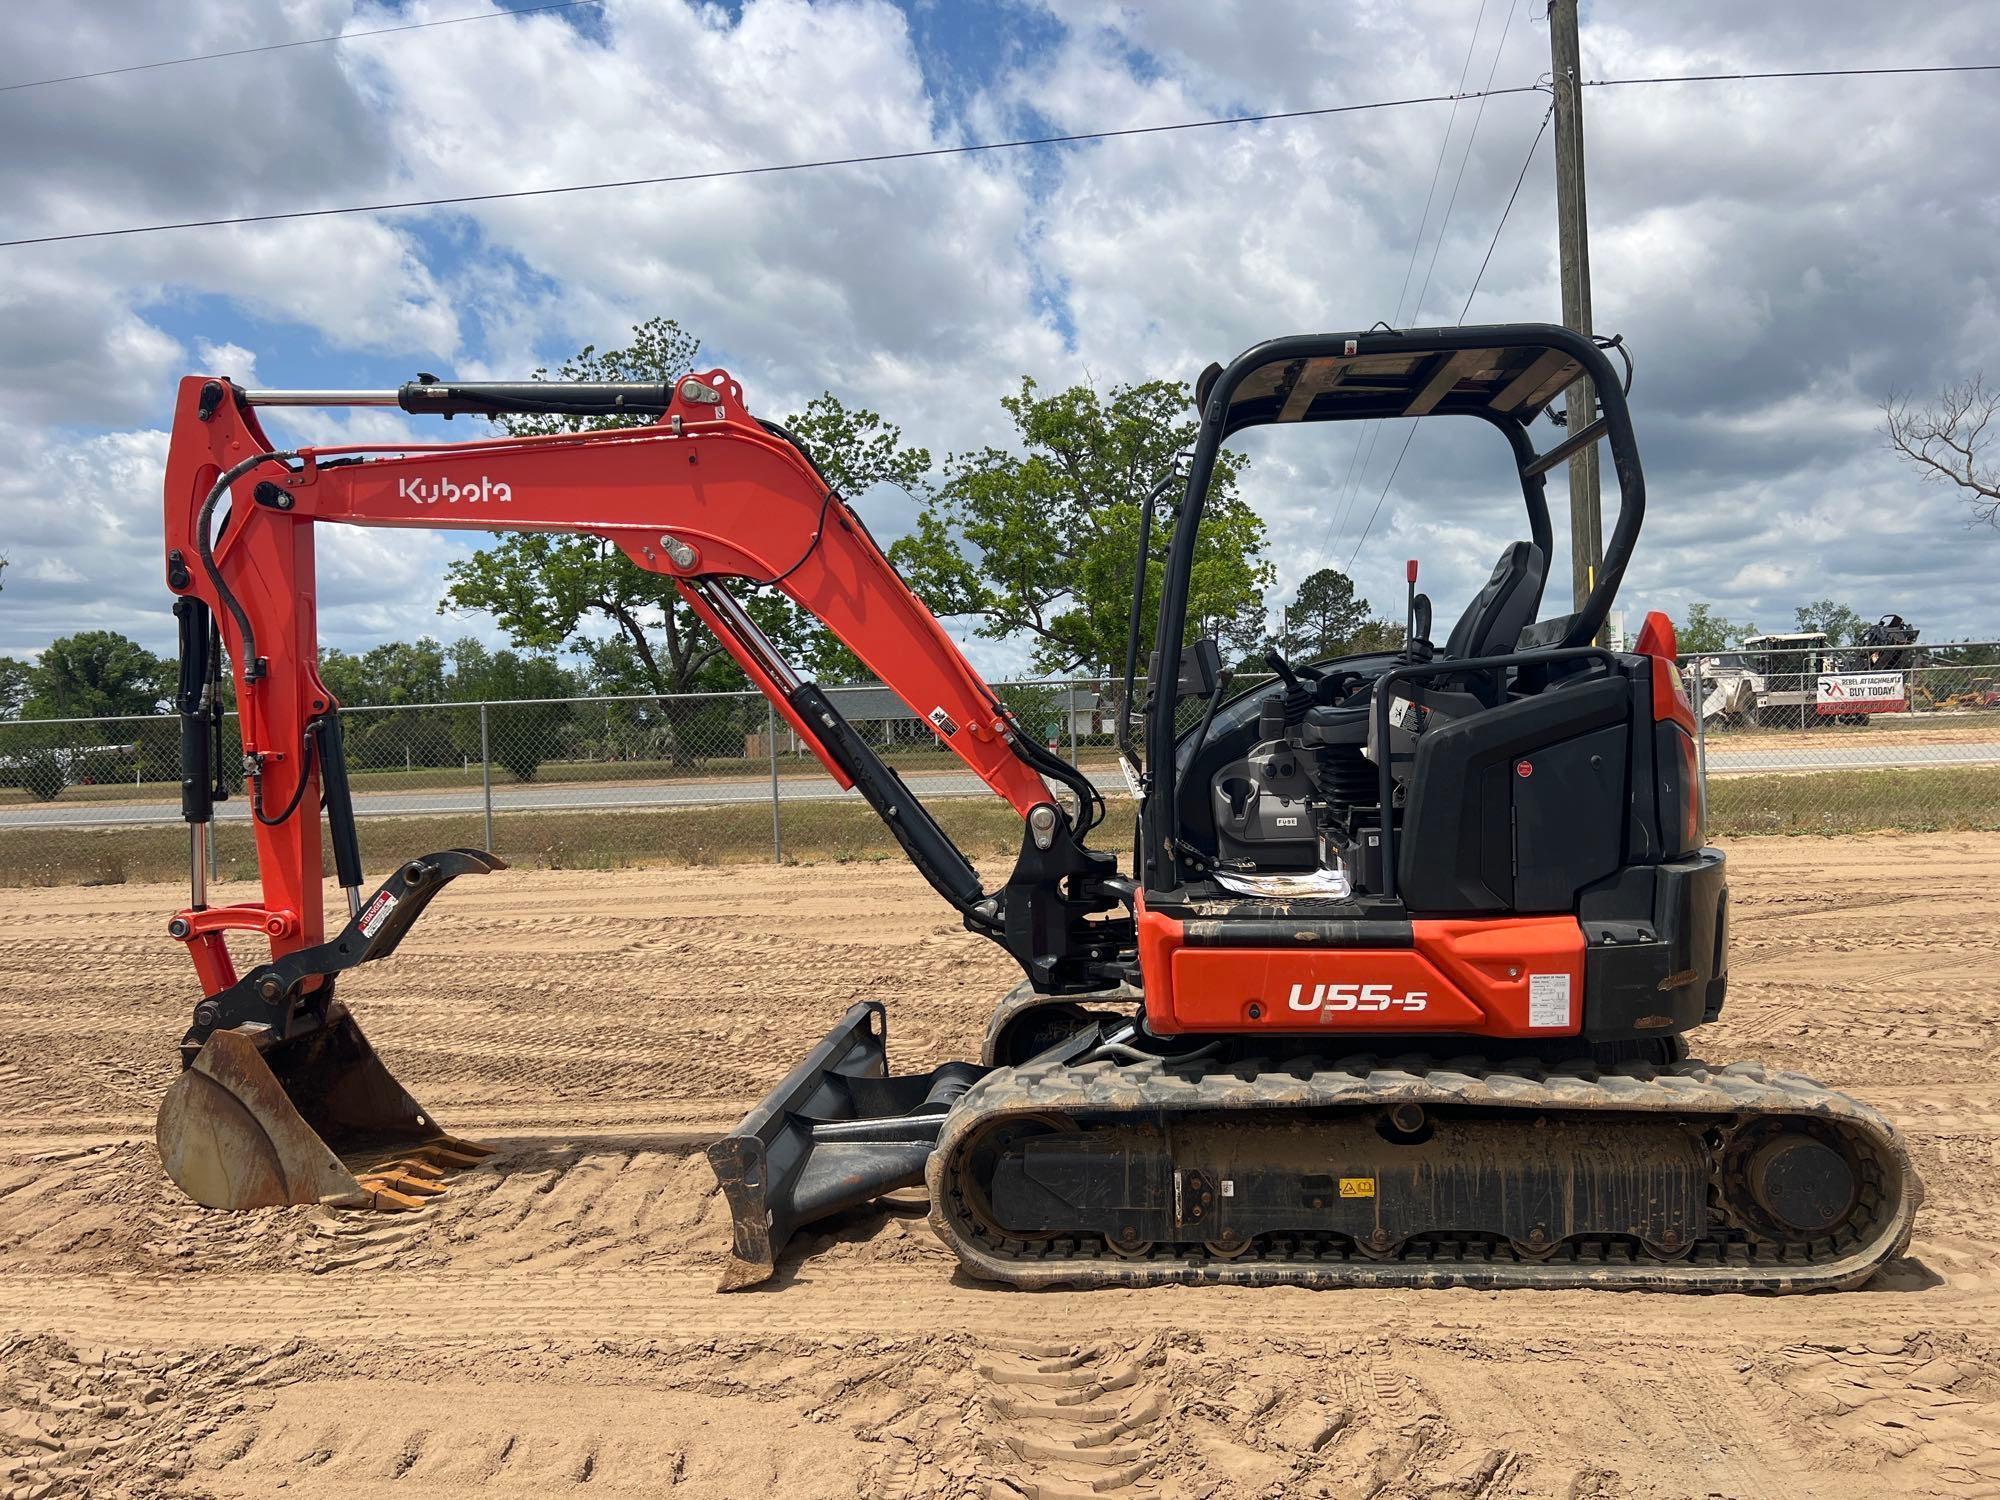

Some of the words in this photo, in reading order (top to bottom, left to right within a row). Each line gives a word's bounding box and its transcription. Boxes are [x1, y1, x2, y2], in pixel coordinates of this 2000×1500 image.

[399, 476, 511, 503] Kubota
[1860, 677, 1901, 685] ATTACHMENTS
[1850, 688, 1866, 696] BUY
[1868, 686, 1895, 696] TODAY!
[1288, 984, 1427, 1011] U55-5
